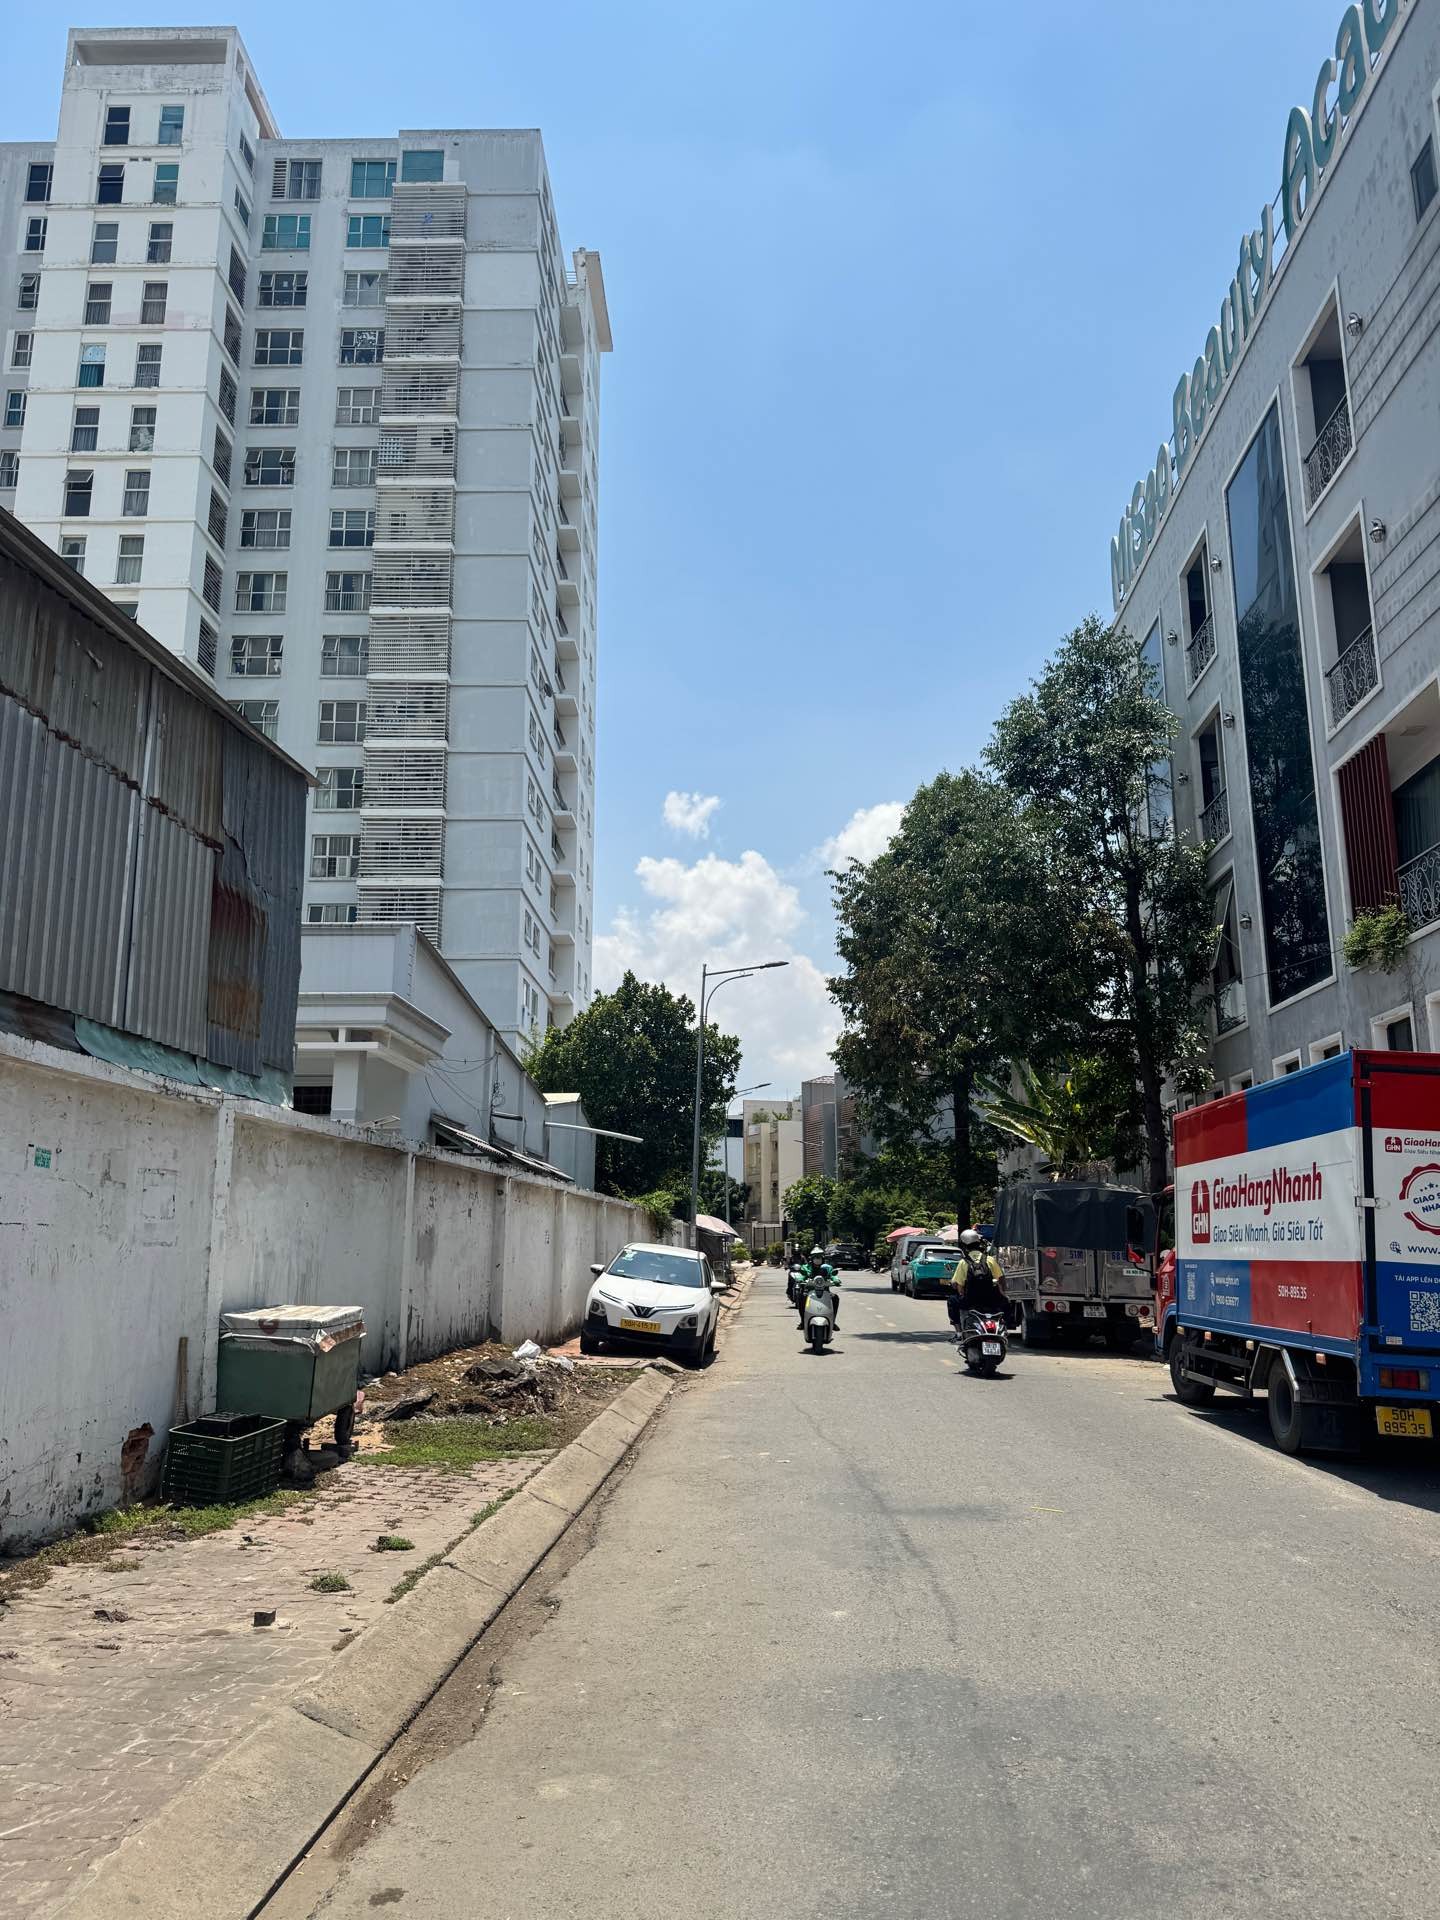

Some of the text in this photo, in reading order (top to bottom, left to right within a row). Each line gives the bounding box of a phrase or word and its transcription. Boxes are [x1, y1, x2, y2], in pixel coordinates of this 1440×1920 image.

[1173, 204, 1273, 480] Beauty
[1213, 1161, 1322, 1216] GiaoHangNhanh
[1413, 1194, 1435, 1205] GIAO
[1193, 1212, 1209, 1235] GHN
[1213, 1217, 1323, 1243] Giao Siêu Nhanh, Giá Siêu Tốt
[1406, 1275, 1419, 1283] APP
[1278, 1285, 1307, 1300] 50H-895.35
[1391, 1409, 1415, 1421] 50H
[1384, 1421, 1426, 1435] 895.35
